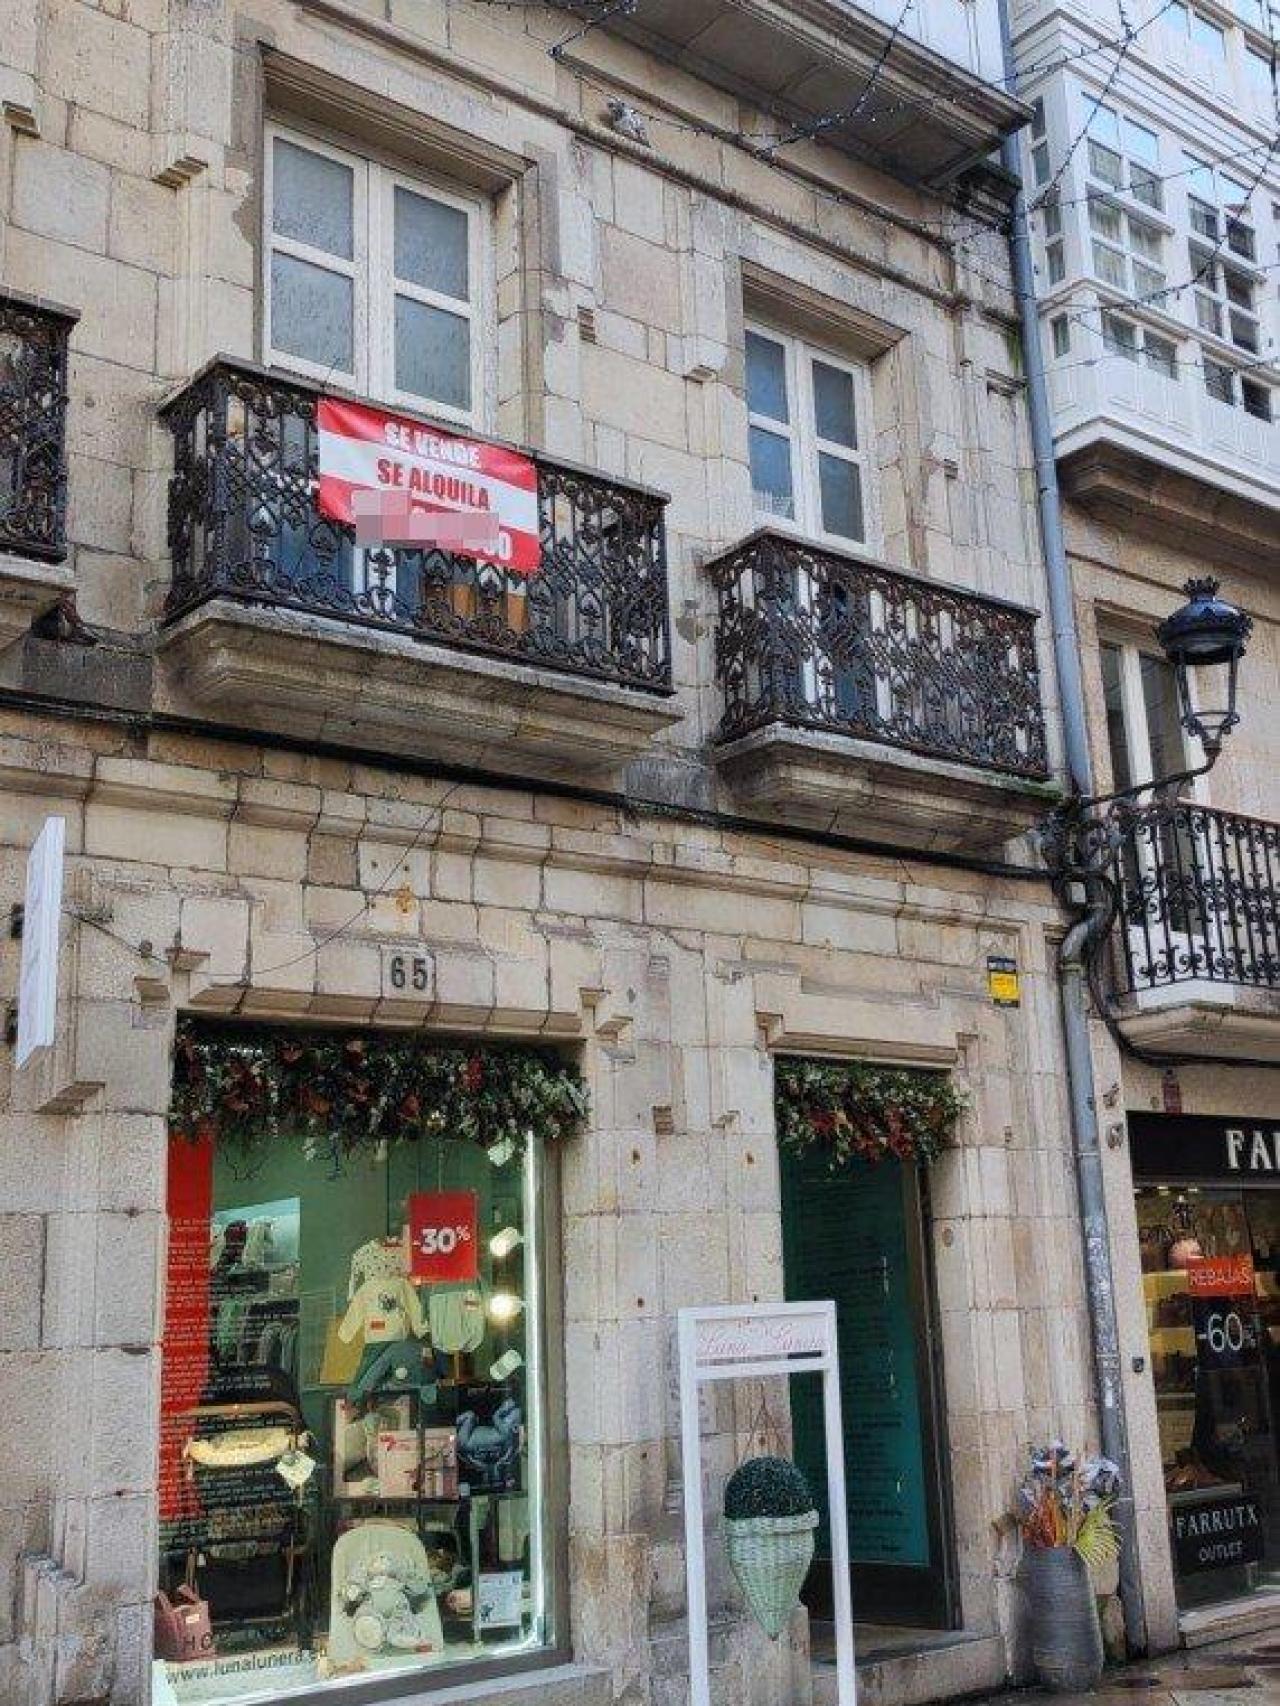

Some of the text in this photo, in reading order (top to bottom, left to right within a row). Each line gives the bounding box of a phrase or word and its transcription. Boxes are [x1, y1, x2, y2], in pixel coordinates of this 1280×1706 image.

[384, 422, 480, 469] SE VENDE
[377, 457, 490, 509] SE ALQUILA
[391, 955, 428, 991] 65
[1190, 1265, 1250, 1287] REBAJAS
[1176, 1504, 1259, 1539] FARRUTX
[1199, 1540, 1244, 1562] OUTLET
